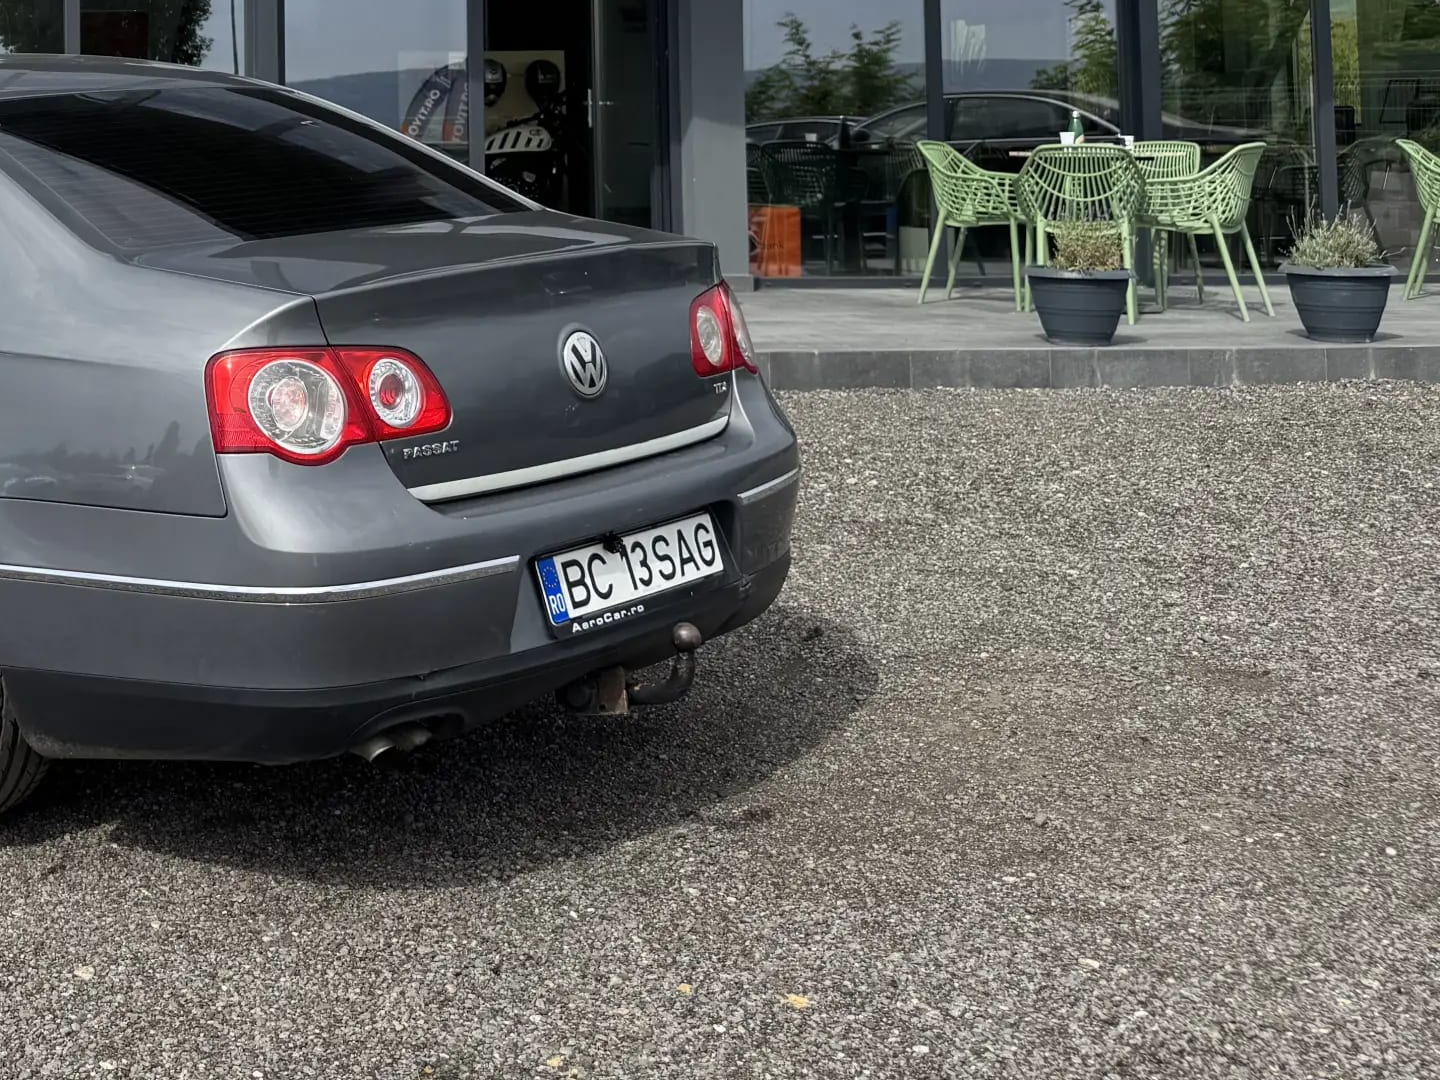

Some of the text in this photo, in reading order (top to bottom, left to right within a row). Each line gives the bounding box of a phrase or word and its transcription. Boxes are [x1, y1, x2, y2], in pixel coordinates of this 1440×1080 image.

[403, 440, 460, 460] PASSAT
[561, 552, 614, 610] BC
[548, 593, 566, 616] RO
[572, 604, 645, 634] AeroCar.ro
